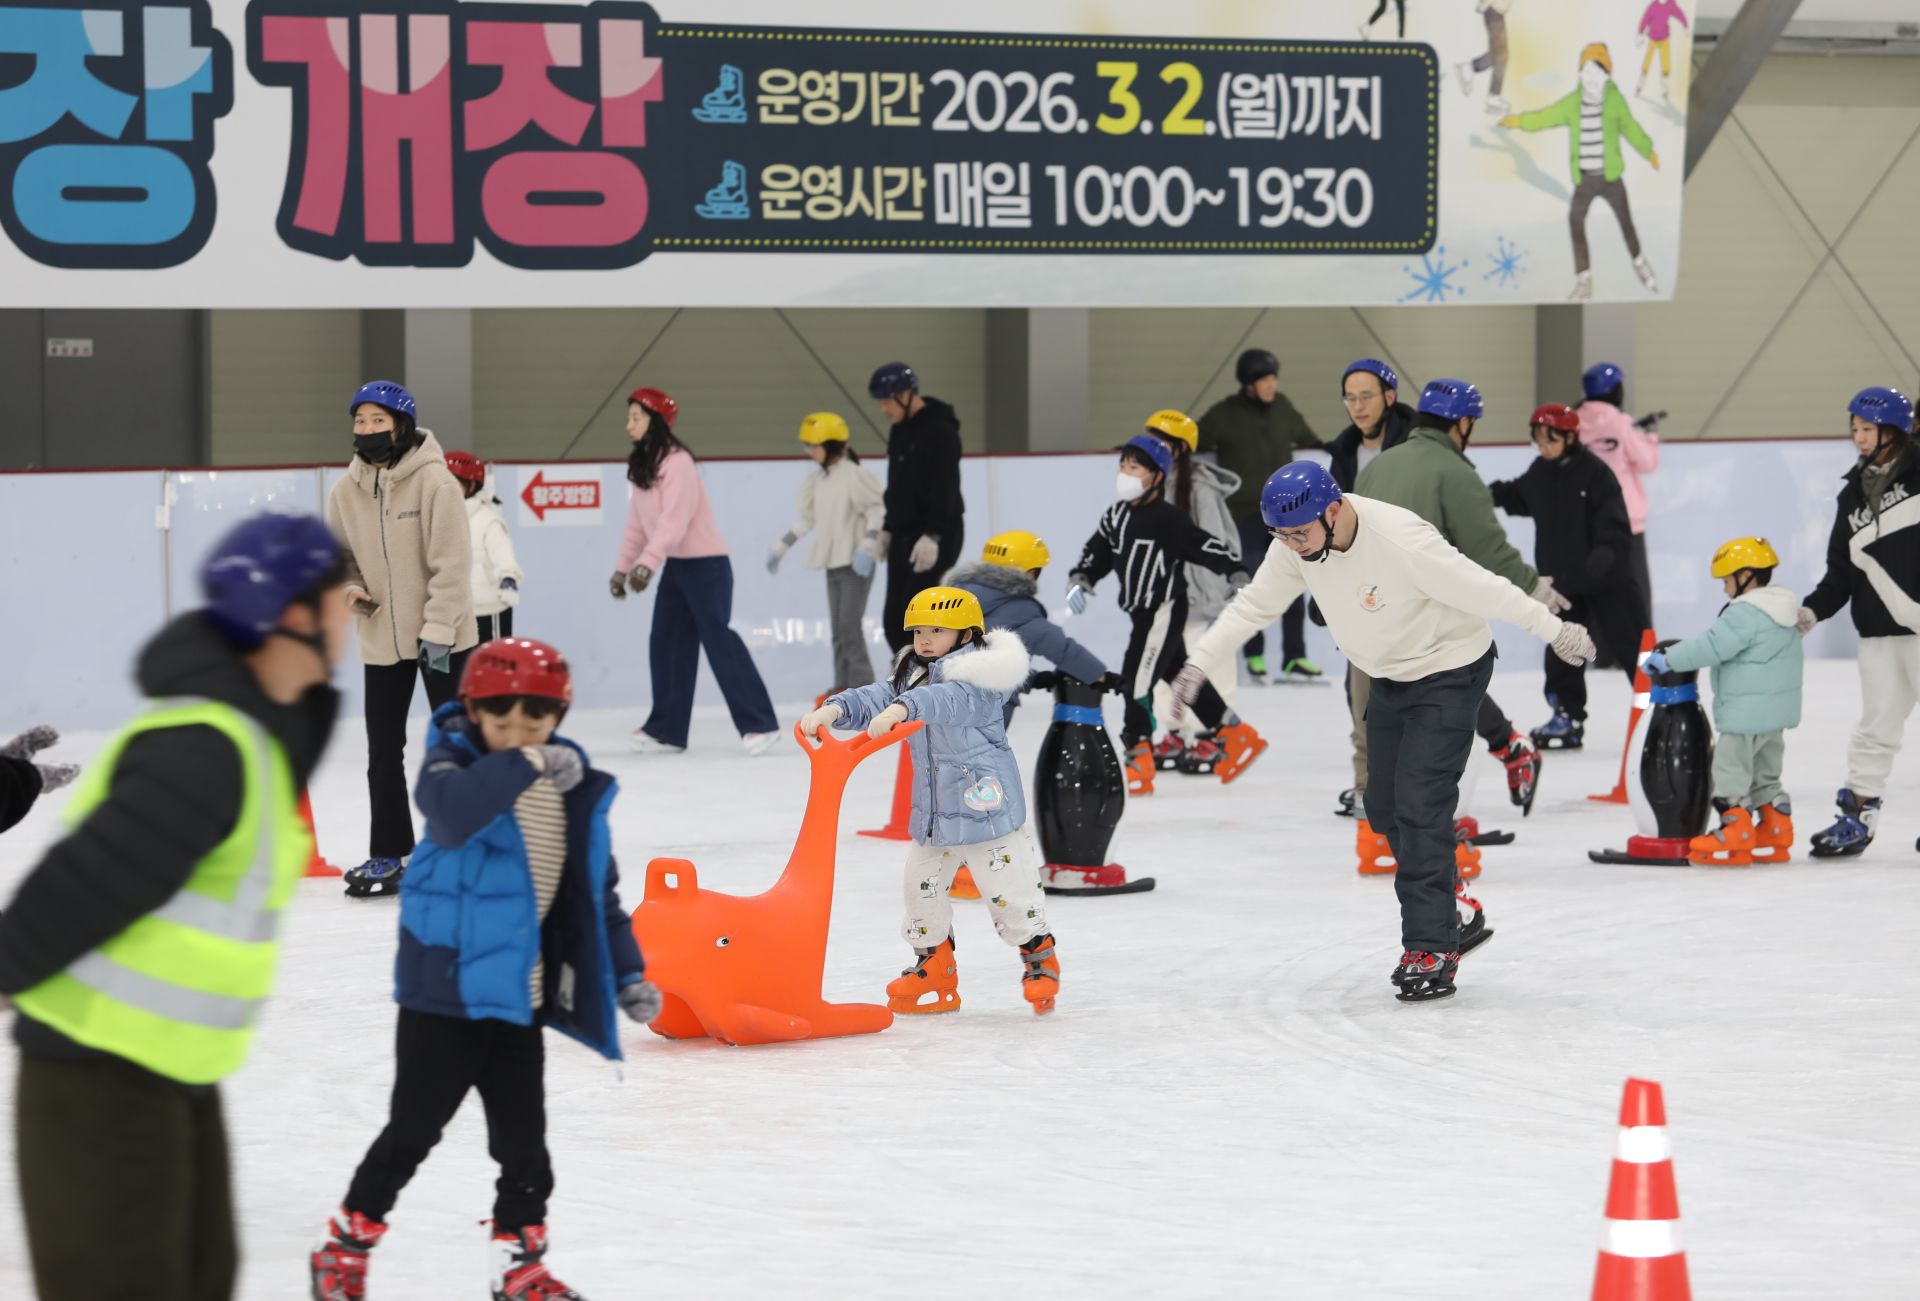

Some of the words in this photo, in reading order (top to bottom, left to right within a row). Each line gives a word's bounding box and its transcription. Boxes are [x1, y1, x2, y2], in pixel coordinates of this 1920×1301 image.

[0, 5, 213, 245] 장
[262, 13, 664, 247] 개장
[757, 68, 925, 126] 운영기간
[760, 164, 927, 221] 운영시간
[934, 161, 1032, 228] 매일
[1045, 164, 1374, 228] 10:00~19:30
[1848, 482, 1909, 533] Koak
